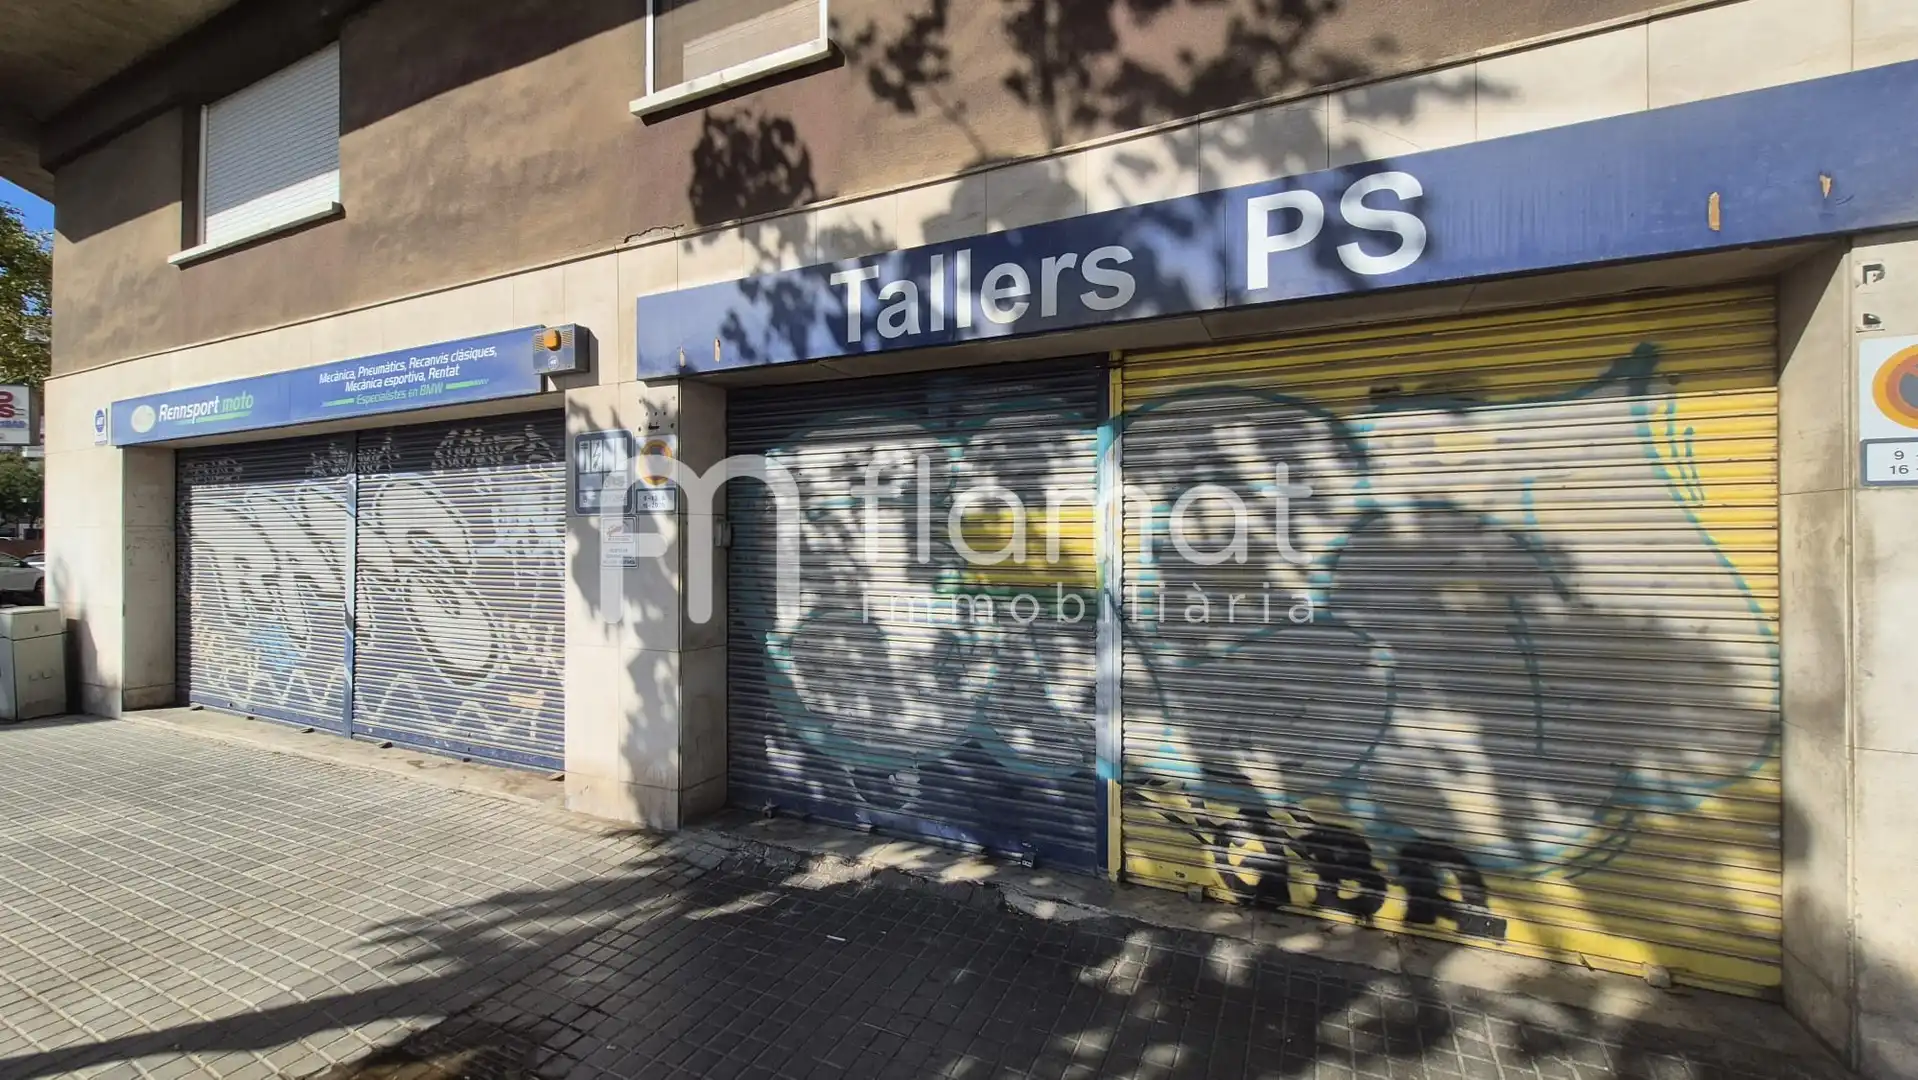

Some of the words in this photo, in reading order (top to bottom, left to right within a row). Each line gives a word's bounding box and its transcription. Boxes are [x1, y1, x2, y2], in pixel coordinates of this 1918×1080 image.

[830, 244, 1137, 343] Tallers
[1246, 170, 1428, 291] PS
[409, 351, 450, 369] Recanvis
[383, 370, 426, 388] esportiva,
[428, 363, 460, 380] Rentat
[408, 388, 418, 397] en
[420, 381, 444, 396] BMW
[158, 396, 221, 424] Rennsport
[222, 390, 254, 413] moto
[1893, 450, 1905, 461] 9
[1889, 464, 1909, 475] 16
